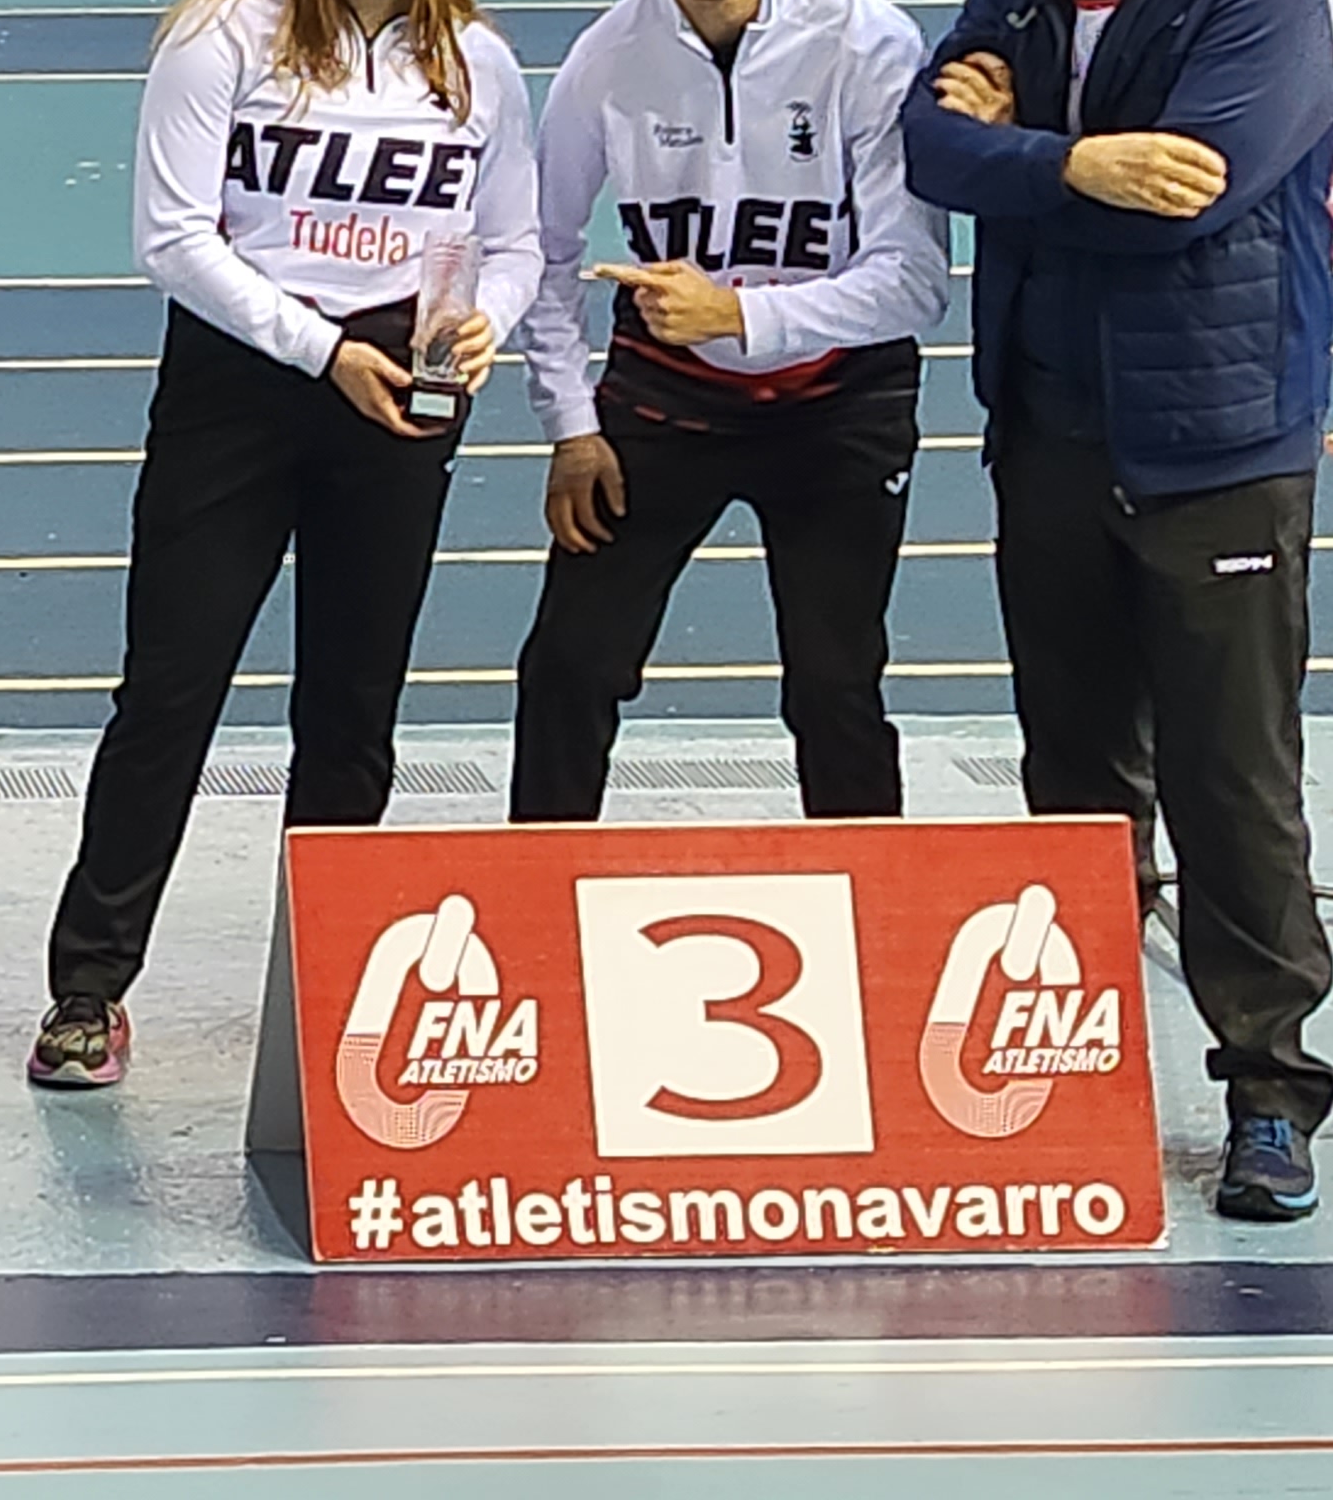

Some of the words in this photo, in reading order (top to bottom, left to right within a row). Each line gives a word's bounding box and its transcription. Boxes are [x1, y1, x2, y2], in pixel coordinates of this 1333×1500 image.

[290, 209, 410, 265] Tudela
[407, 999, 539, 1059] FNA
[638, 913, 823, 1122] 3
[990, 988, 1121, 1049] FNA
[397, 1057, 538, 1086] ATLETISMO
[981, 1047, 1121, 1074] ATLETISMO
[349, 1175, 1126, 1249] #atletismonavarro
